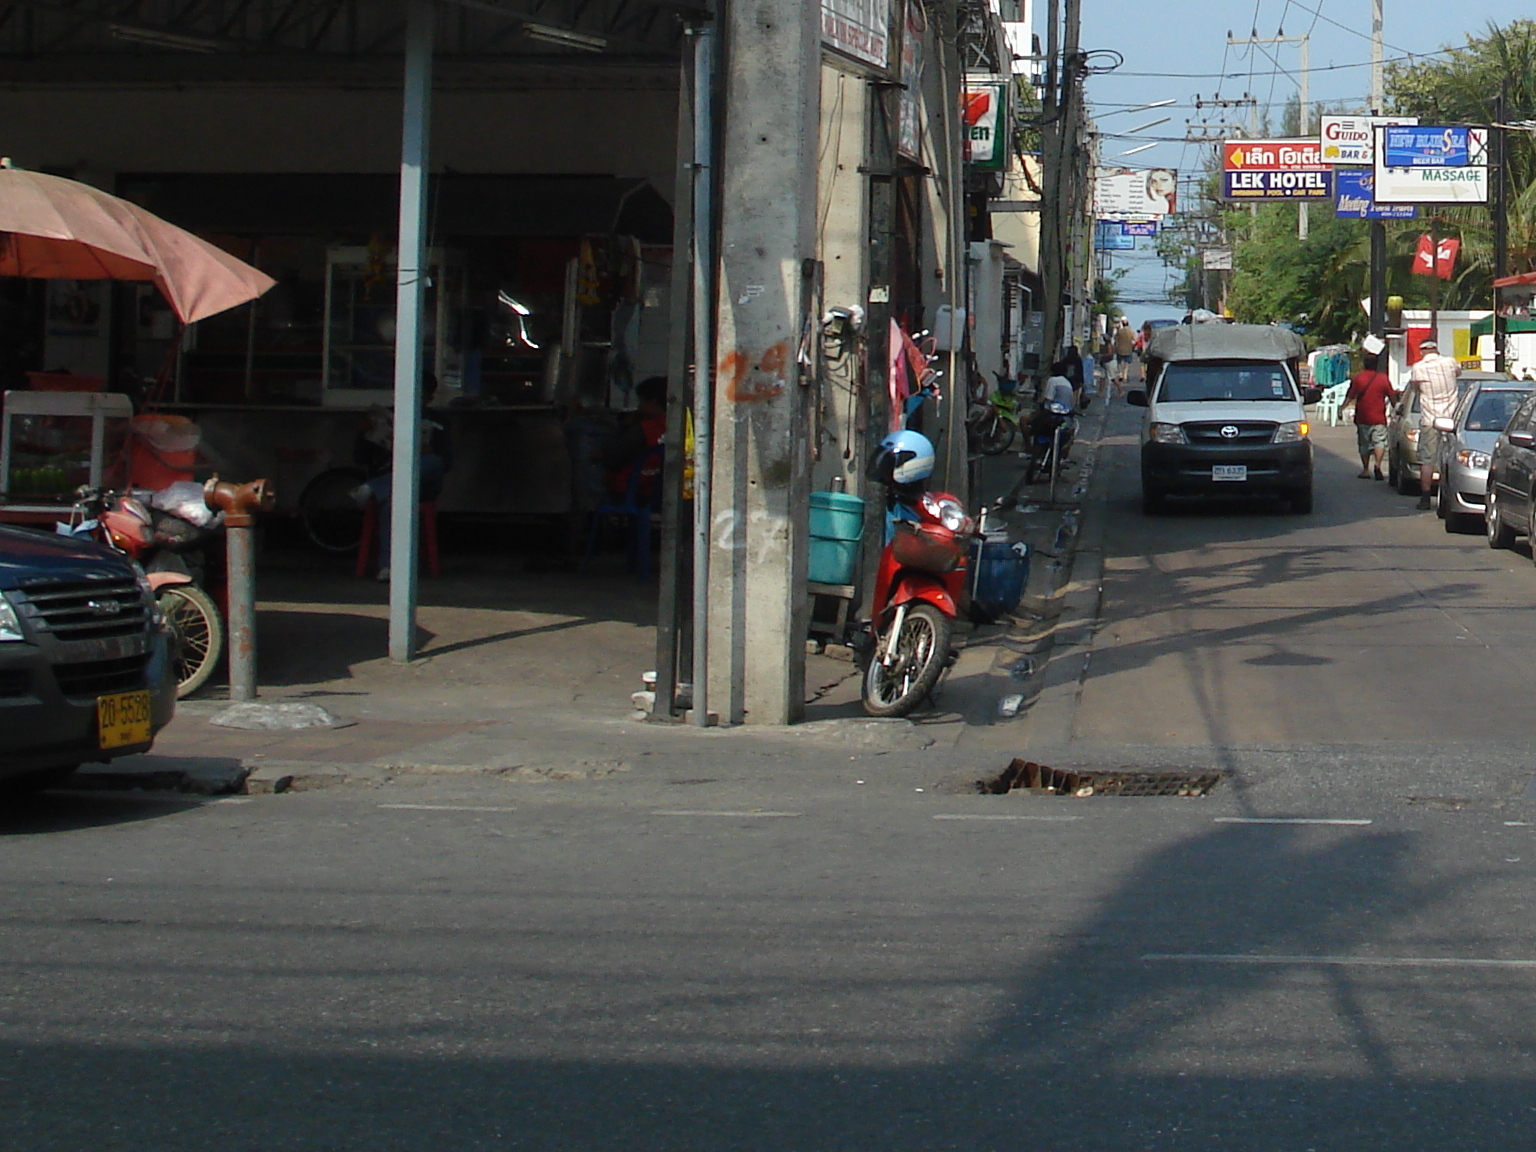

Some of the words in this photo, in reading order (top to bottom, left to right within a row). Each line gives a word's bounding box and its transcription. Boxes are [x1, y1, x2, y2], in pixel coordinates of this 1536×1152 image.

[1326, 123, 1368, 141] GUIDO
[1245, 147, 1275, 165] เล็ก
[1341, 150, 1359, 159] BAR
[1361, 150, 1368, 159] &
[1231, 173, 1264, 188] LEK
[1269, 173, 1326, 188] HOTEL
[1422, 170, 1481, 181] MASSAGE
